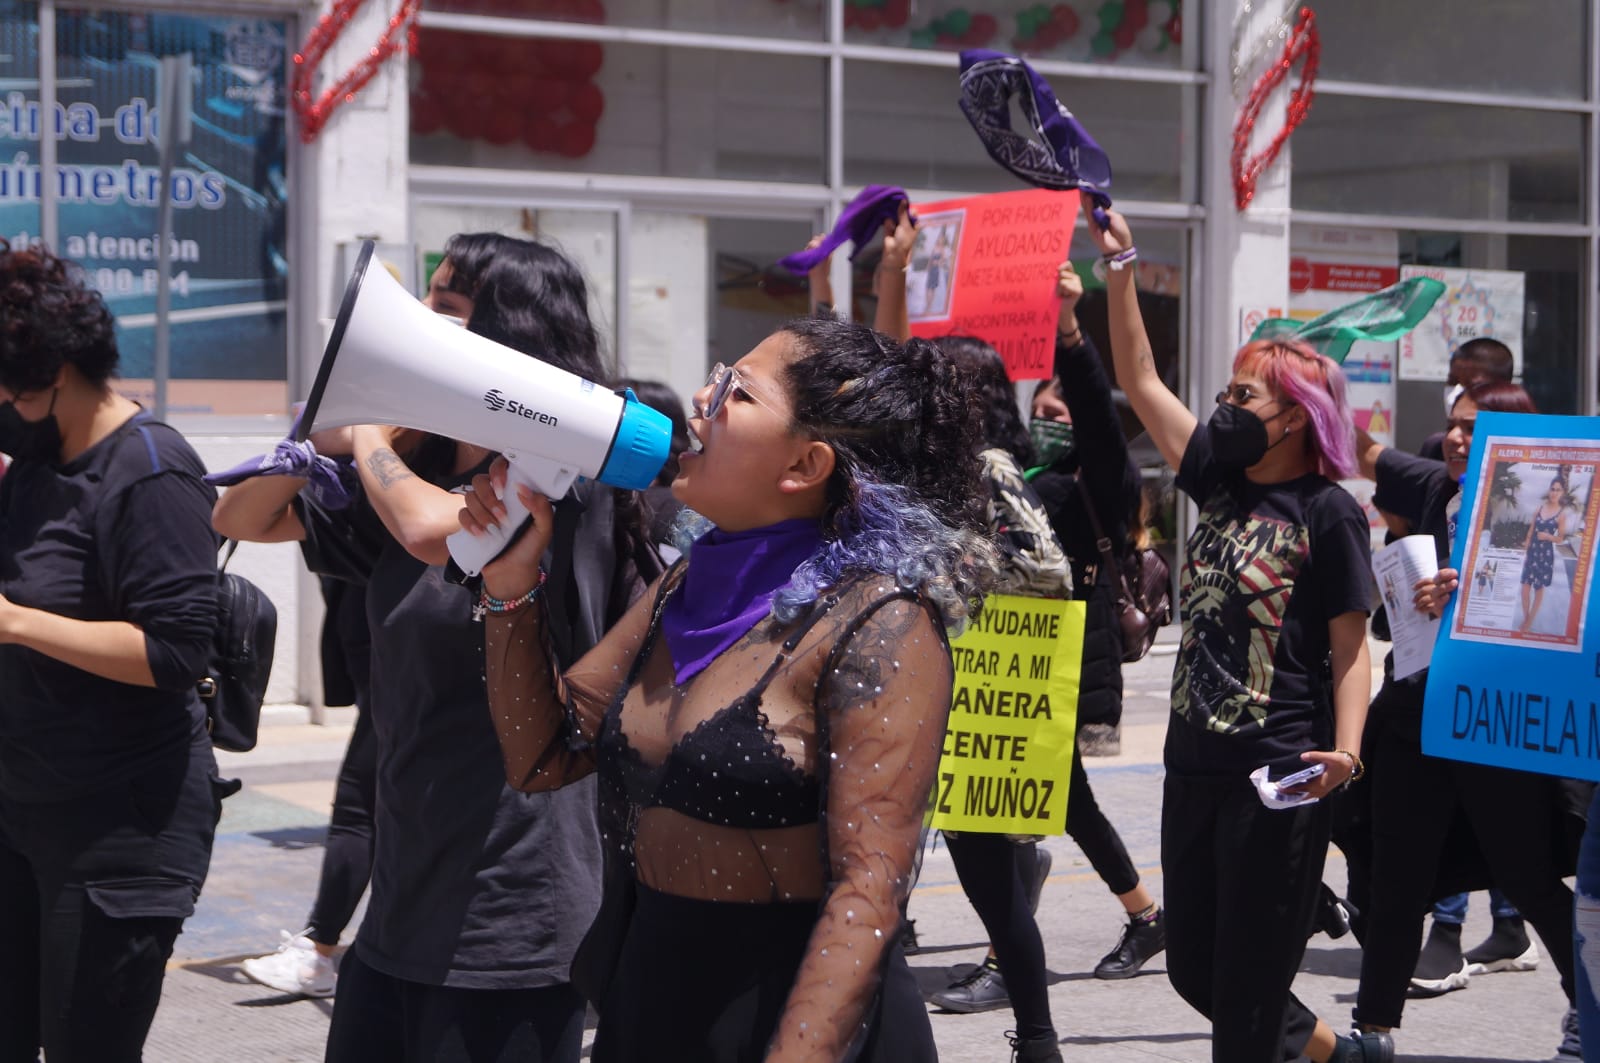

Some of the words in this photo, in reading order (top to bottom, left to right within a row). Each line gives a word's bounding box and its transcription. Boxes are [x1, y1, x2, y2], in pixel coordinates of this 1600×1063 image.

[0, 91, 99, 141] ina
[982, 208, 1012, 226] POR
[1015, 203, 1063, 222] FAVOR
[973, 230, 1064, 259] AYUDANOS
[1042, 310, 1052, 326] A
[1457, 306, 1478, 323] 20
[506, 400, 558, 427] Steren
[968, 608, 1060, 639] AYUDAME
[1007, 653, 1021, 678] A
[1029, 655, 1051, 680] MI
[952, 682, 1053, 720] AÑERA
[1452, 684, 1579, 758] DANIELA
[938, 772, 955, 814] Z
[964, 767, 1054, 820] MUÑOZ
